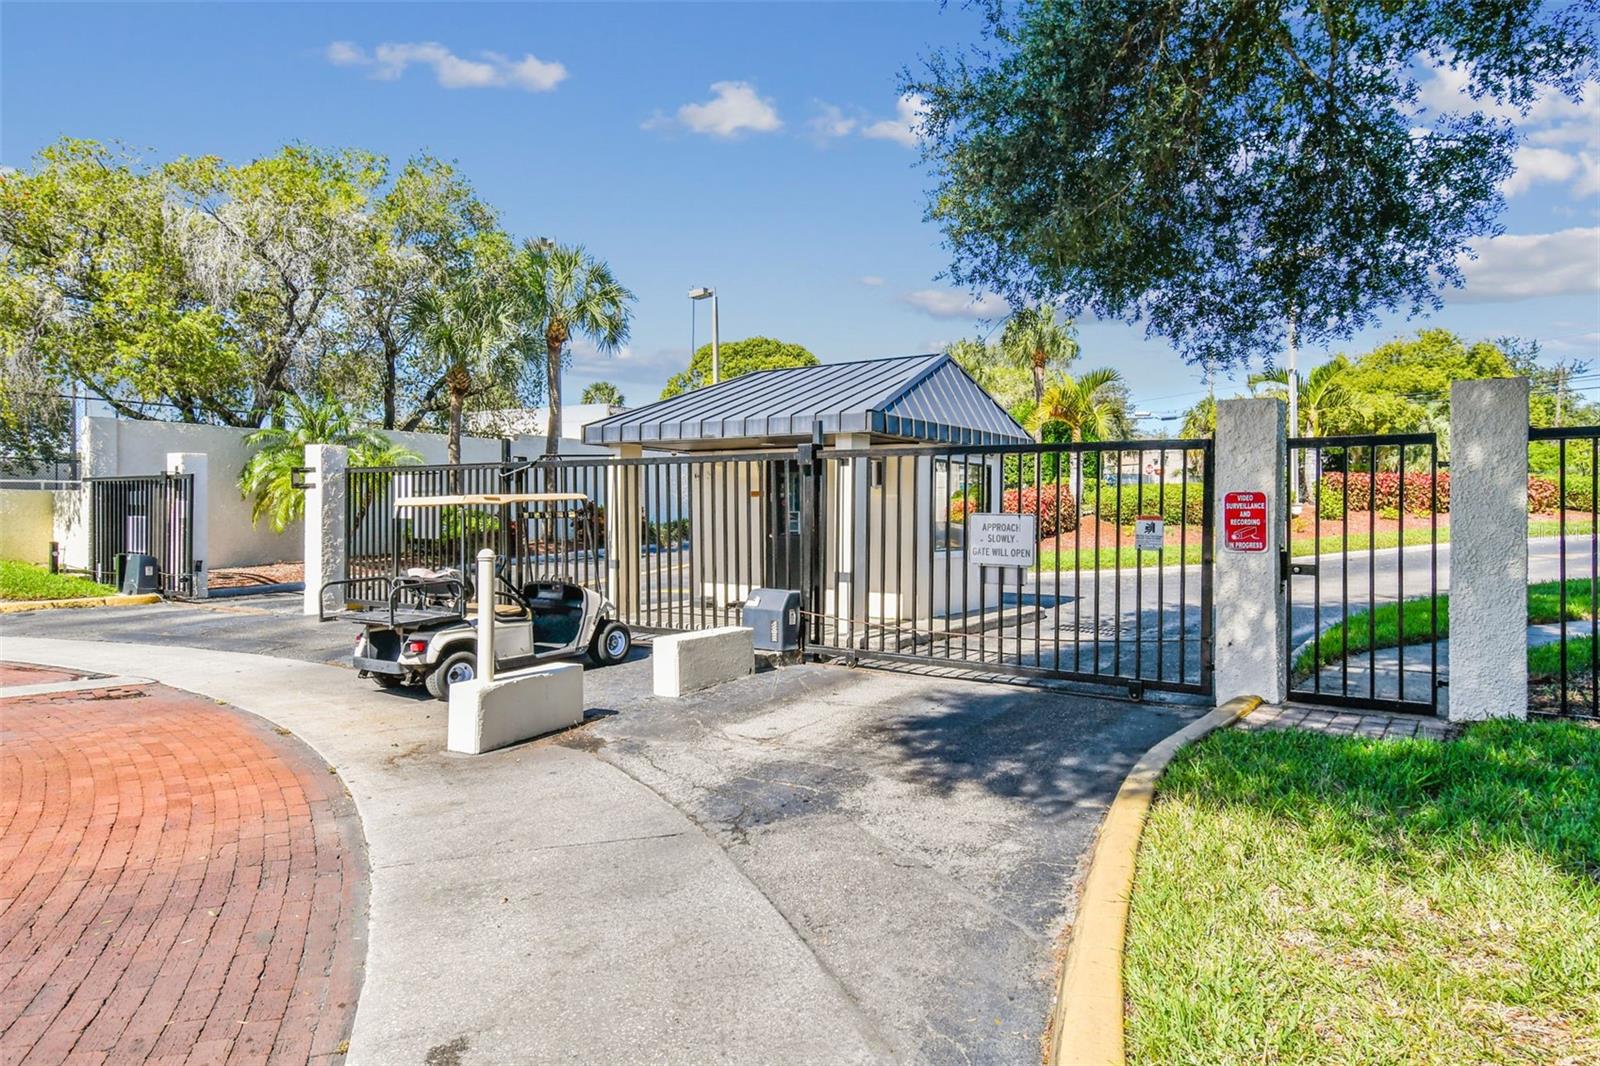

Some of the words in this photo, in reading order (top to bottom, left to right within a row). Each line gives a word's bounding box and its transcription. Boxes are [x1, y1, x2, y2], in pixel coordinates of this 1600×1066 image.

[982, 523, 1022, 532] APPROACH
[987, 534, 1016, 543] SLOWLY
[972, 547, 990, 556] GATE
[992, 548, 1009, 557] WILL
[1010, 548, 1031, 558] OPEN
